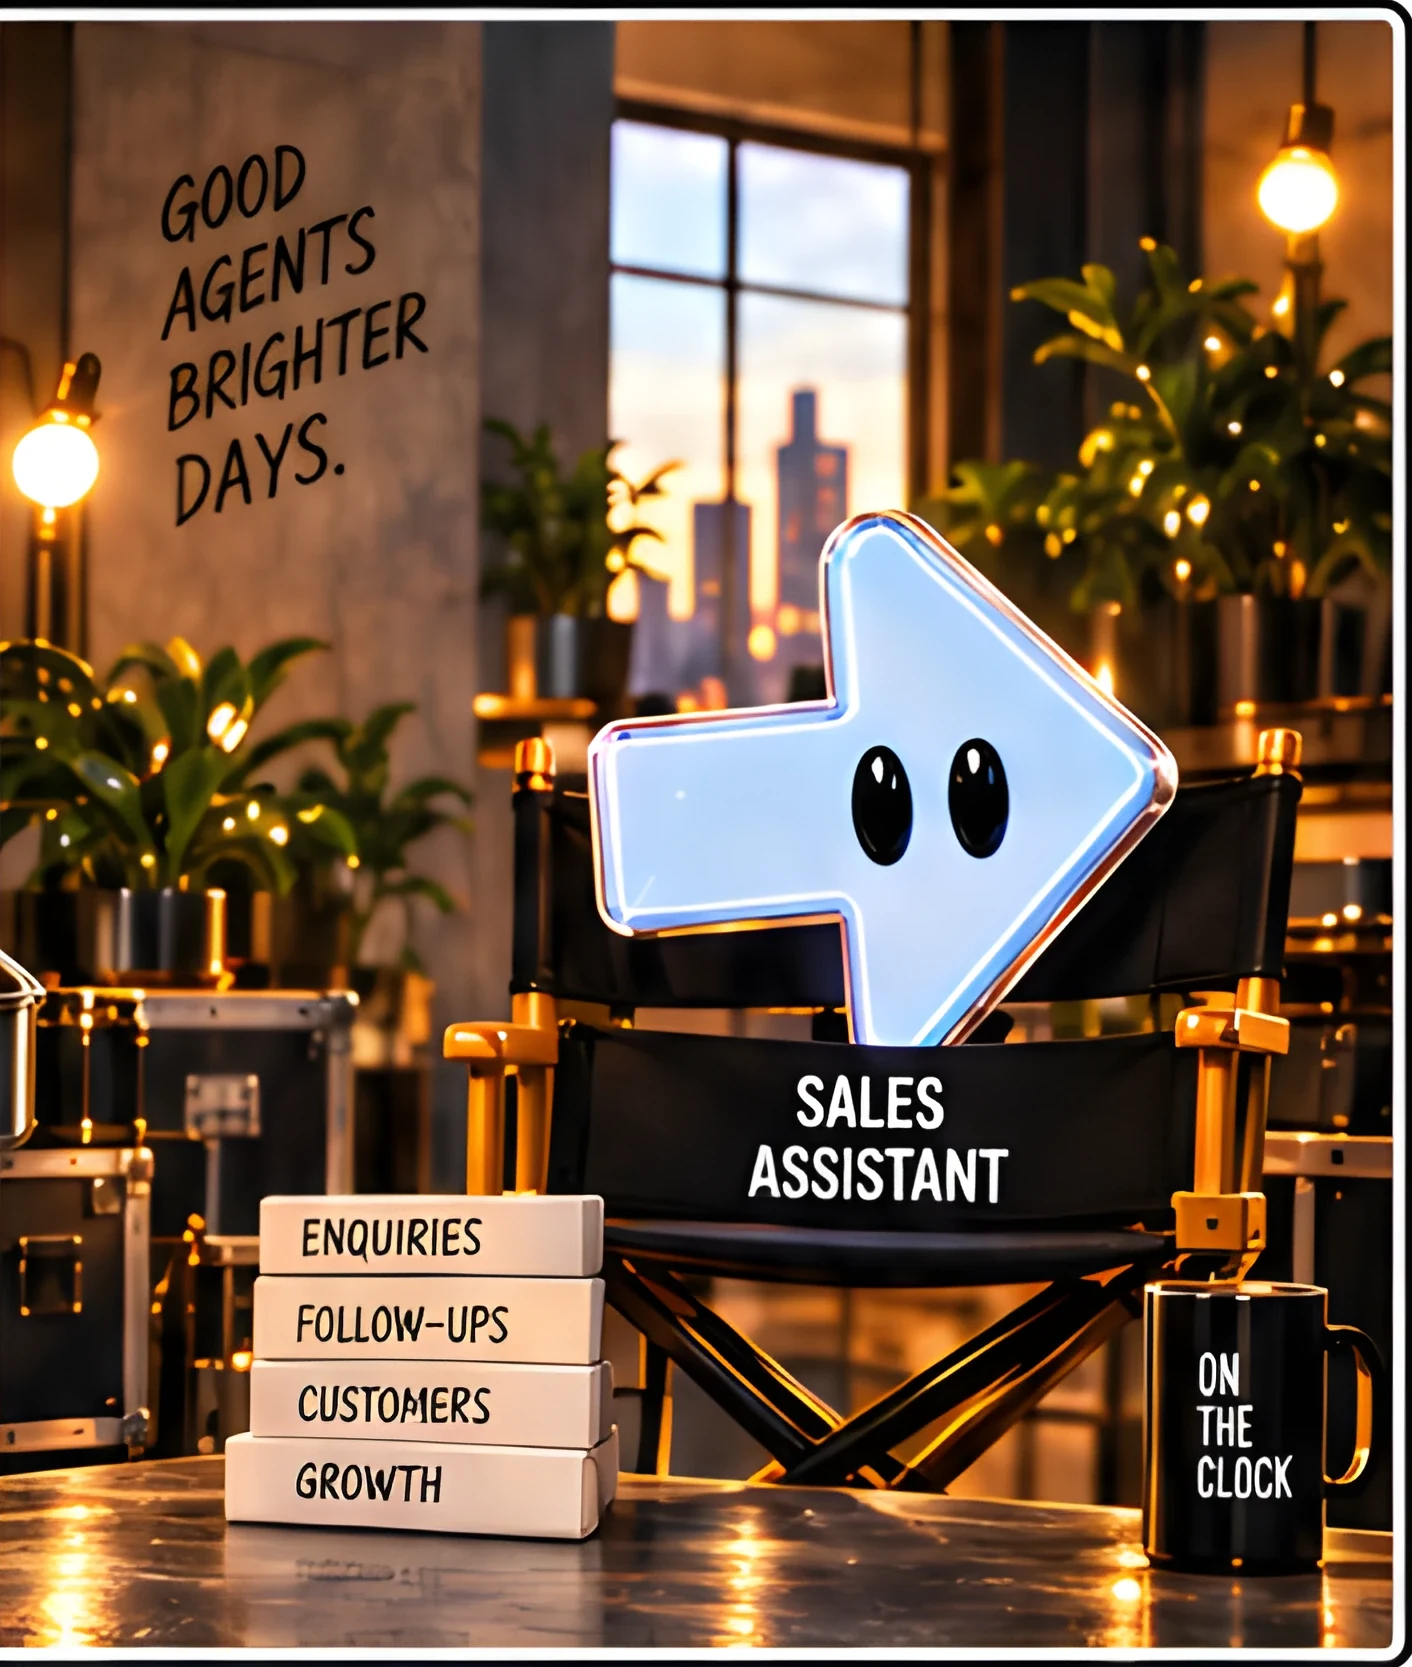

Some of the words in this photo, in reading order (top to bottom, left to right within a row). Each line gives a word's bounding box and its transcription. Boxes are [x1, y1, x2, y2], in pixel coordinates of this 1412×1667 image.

[161, 144, 306, 242] GOOD
[160, 205, 376, 341] AGENTS
[167, 291, 429, 432] BRIGHTER
[175, 411, 345, 527] DAYS.
[796, 1074, 945, 1130] SALES
[747, 1144, 1009, 1204] ASSISTANT
[301, 1217, 483, 1263] ENQUIRIES
[296, 1304, 509, 1344] FOLLOW-UPS
[1198, 1351, 1240, 1397] ON
[298, 1384, 491, 1425] CUSTOMERS
[1196, 1404, 1254, 1449] THE
[295, 1461, 442, 1504] GROWTH
[1197, 1454, 1293, 1499] CLOCK
